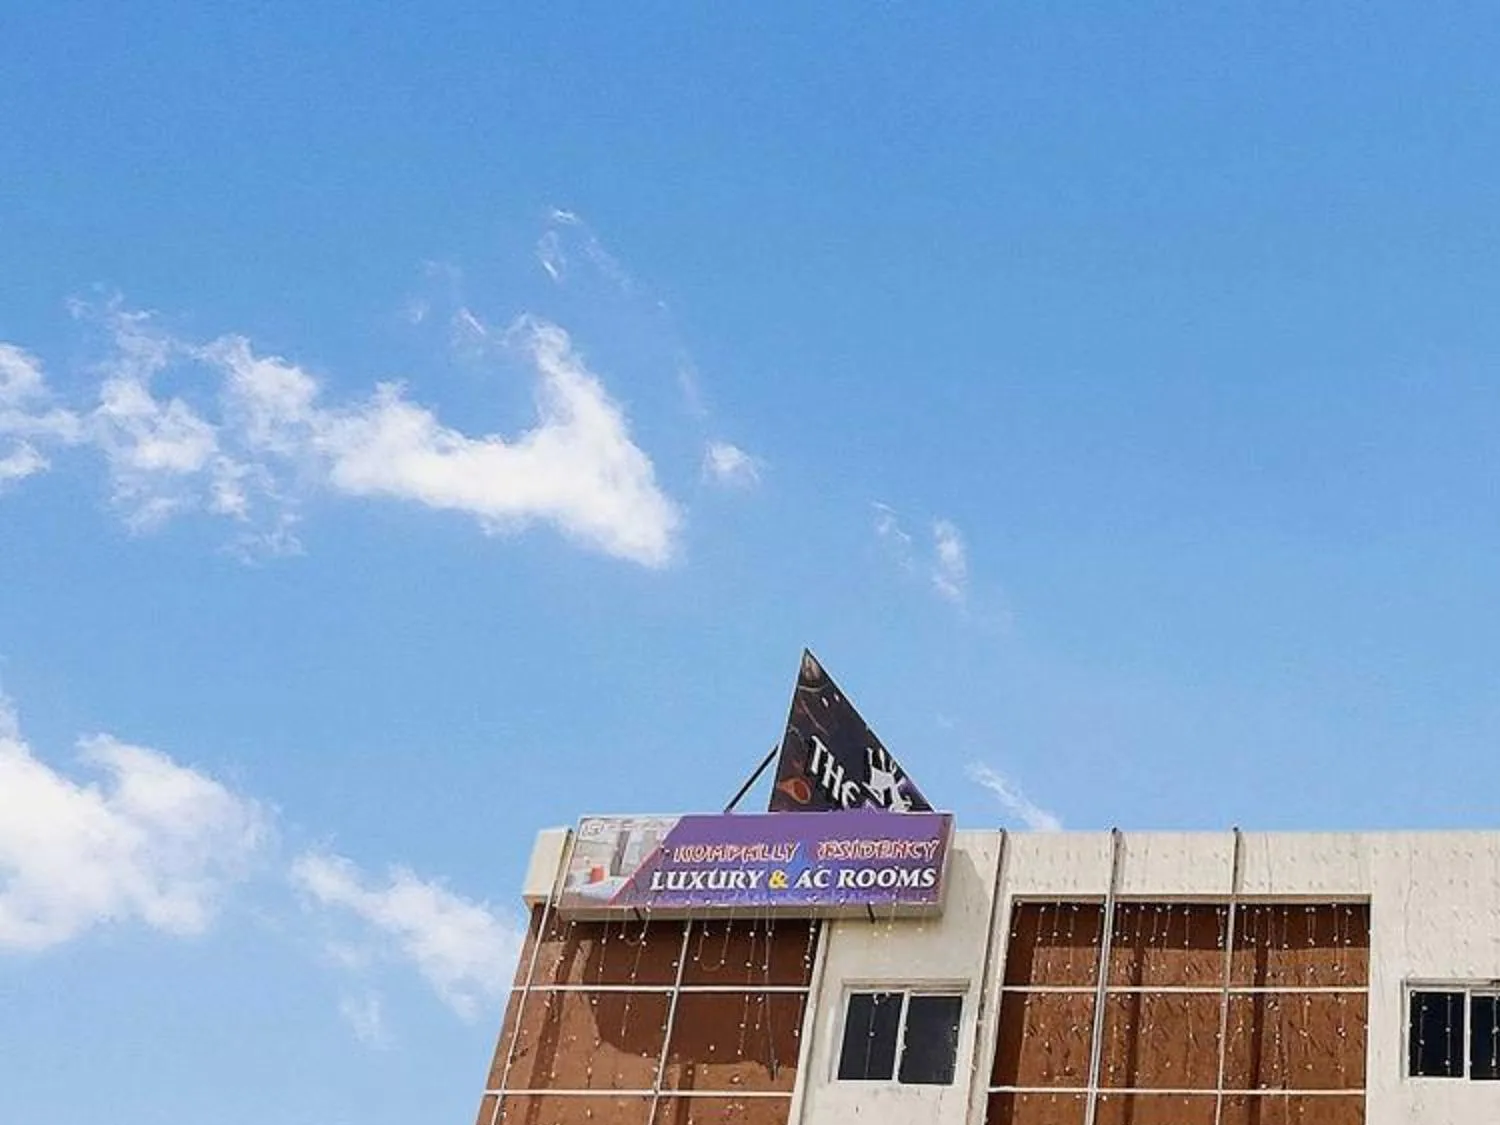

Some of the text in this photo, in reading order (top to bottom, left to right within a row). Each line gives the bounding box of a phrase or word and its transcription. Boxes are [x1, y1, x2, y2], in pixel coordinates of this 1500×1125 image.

[650, 867, 937, 890] LUXURY & AC ROOMS
